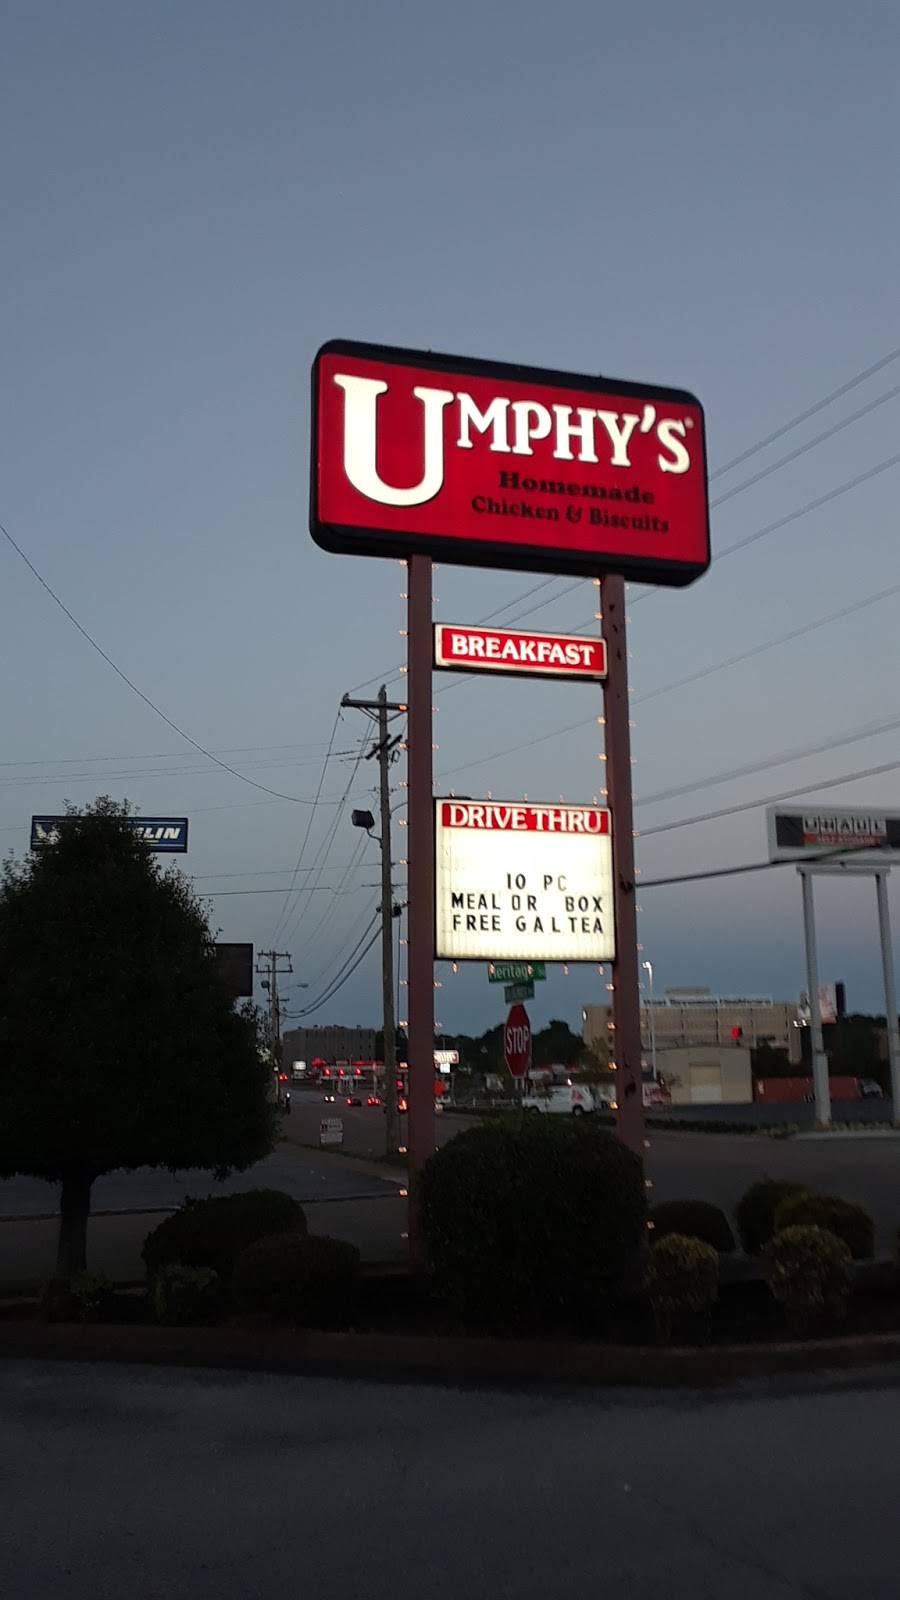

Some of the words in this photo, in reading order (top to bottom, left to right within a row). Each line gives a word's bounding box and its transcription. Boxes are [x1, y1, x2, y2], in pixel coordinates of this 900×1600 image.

[334, 374, 691, 506] UMPHY'S
[499, 471, 655, 504] Homemade
[472, 495, 560, 521] Chicken
[566, 505, 583, 523] &
[589, 507, 669, 533] Biscuits
[451, 633, 595, 666] BREAKFAST
[450, 804, 527, 830] DRIVE
[529, 808, 602, 834] THRU
[543, 874, 567, 891] PC
[451, 892, 501, 909] MEAL
[511, 895, 537, 910] OR
[565, 896, 604, 913] BOX
[453, 914, 501, 931] FREE
[515, 915, 561, 932] GAL
[567, 917, 604, 933] TEA
[506, 1025, 529, 1055] STOP
